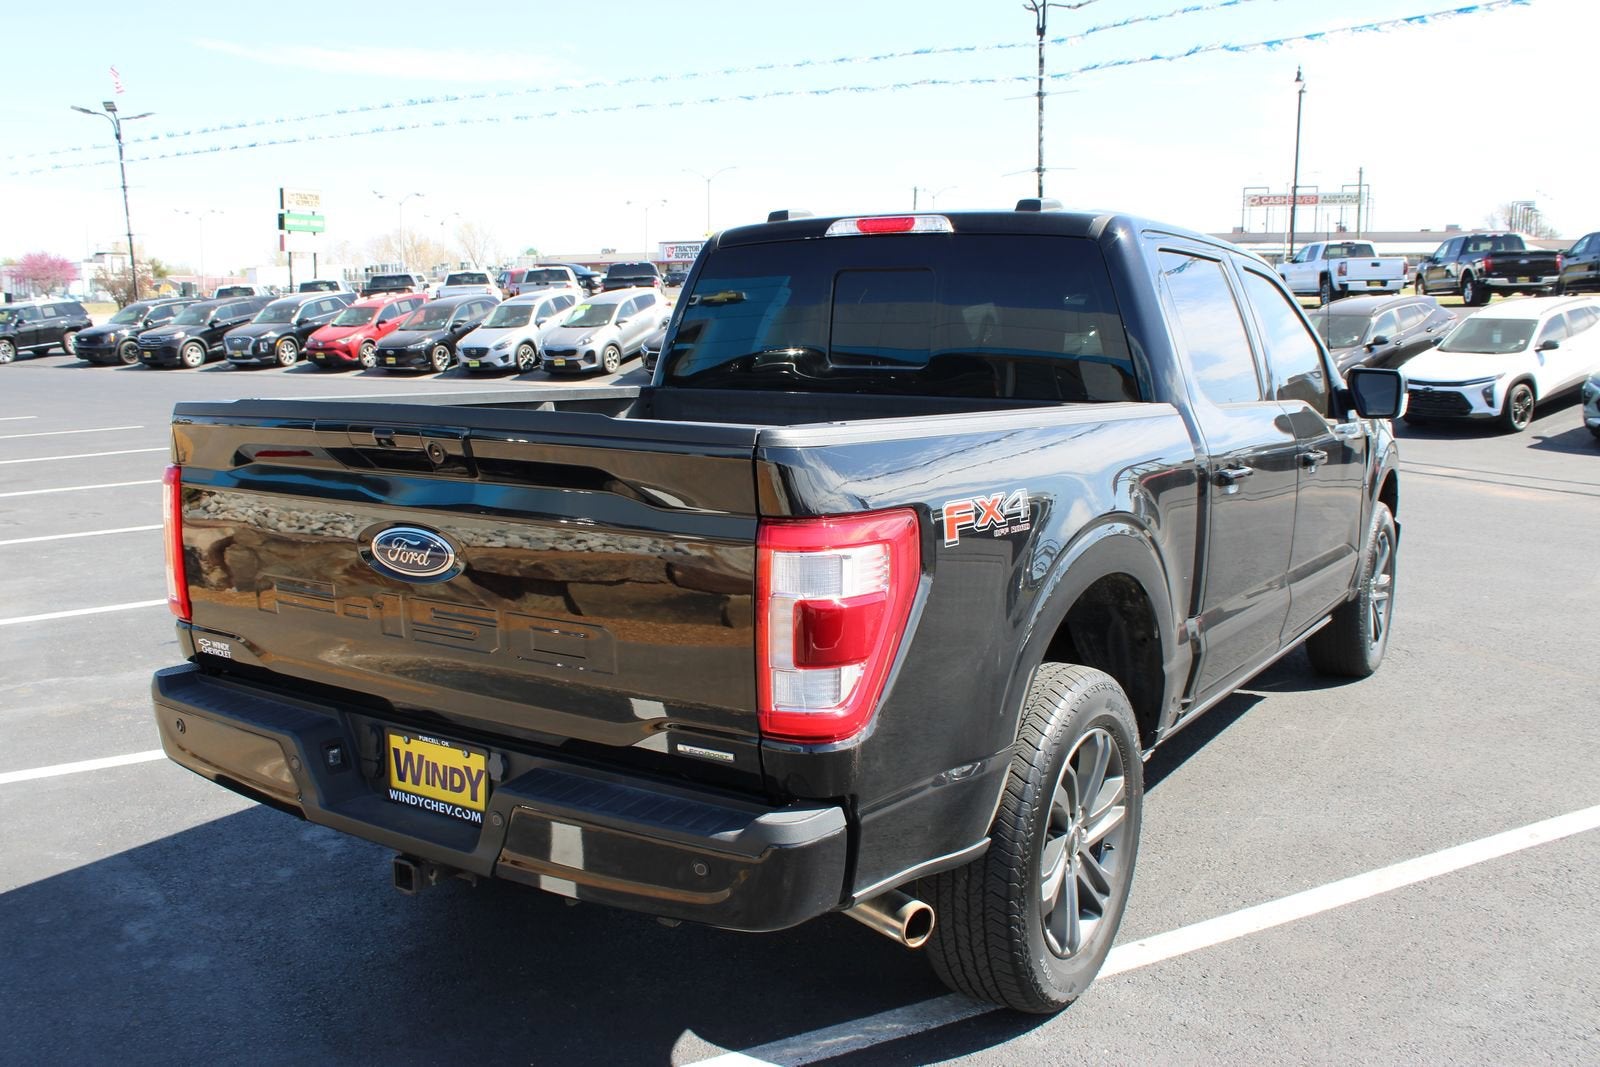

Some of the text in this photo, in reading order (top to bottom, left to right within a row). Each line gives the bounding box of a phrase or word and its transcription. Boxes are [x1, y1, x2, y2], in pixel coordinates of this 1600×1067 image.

[1288, 196, 1317, 205] SVER
[942, 488, 1031, 548] FX4
[387, 537, 431, 566] Ford
[201, 645, 232, 659] CHEVROLET
[211, 640, 230, 651] WINDY
[389, 788, 482, 823] WINDYCHEV.COM
